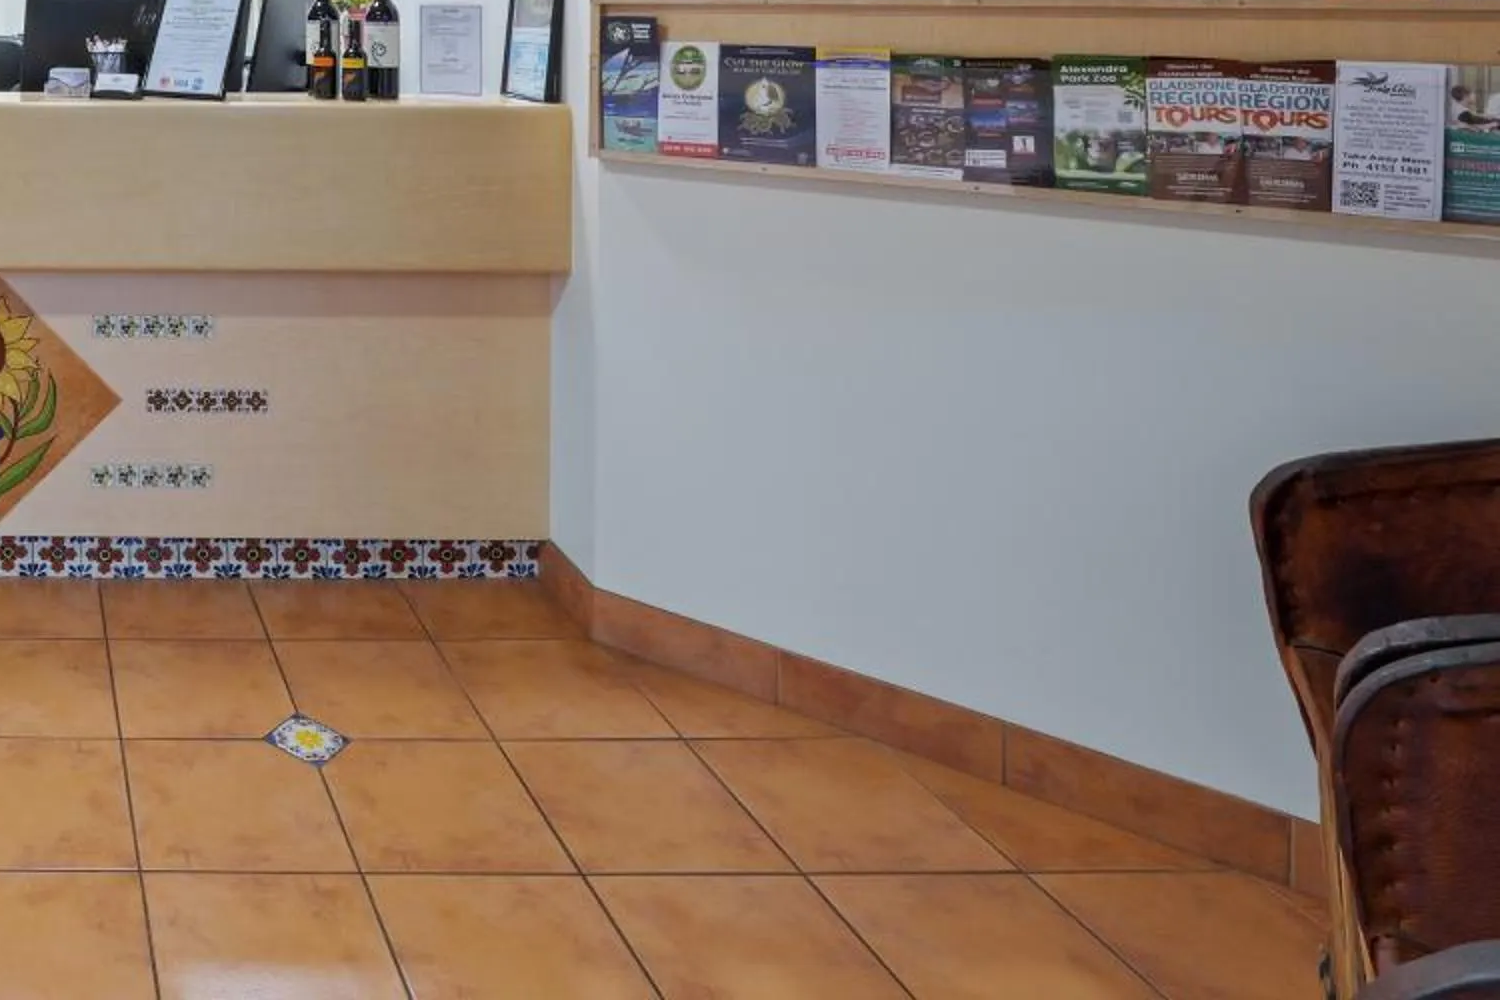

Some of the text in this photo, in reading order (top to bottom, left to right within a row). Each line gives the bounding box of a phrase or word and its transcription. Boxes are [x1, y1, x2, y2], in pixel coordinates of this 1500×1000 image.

[1059, 64, 1128, 75] Alexandra
[1059, 74, 1117, 83] Park Zoo
[1149, 79, 1238, 91] GLADSTONE
[1238, 81, 1331, 96] GLADSTONE
[1150, 91, 1238, 106] REGION
[1238, 93, 1330, 110] REGION
[1154, 106, 1238, 127] TOURS
[1240, 109, 1329, 131] TOURS
